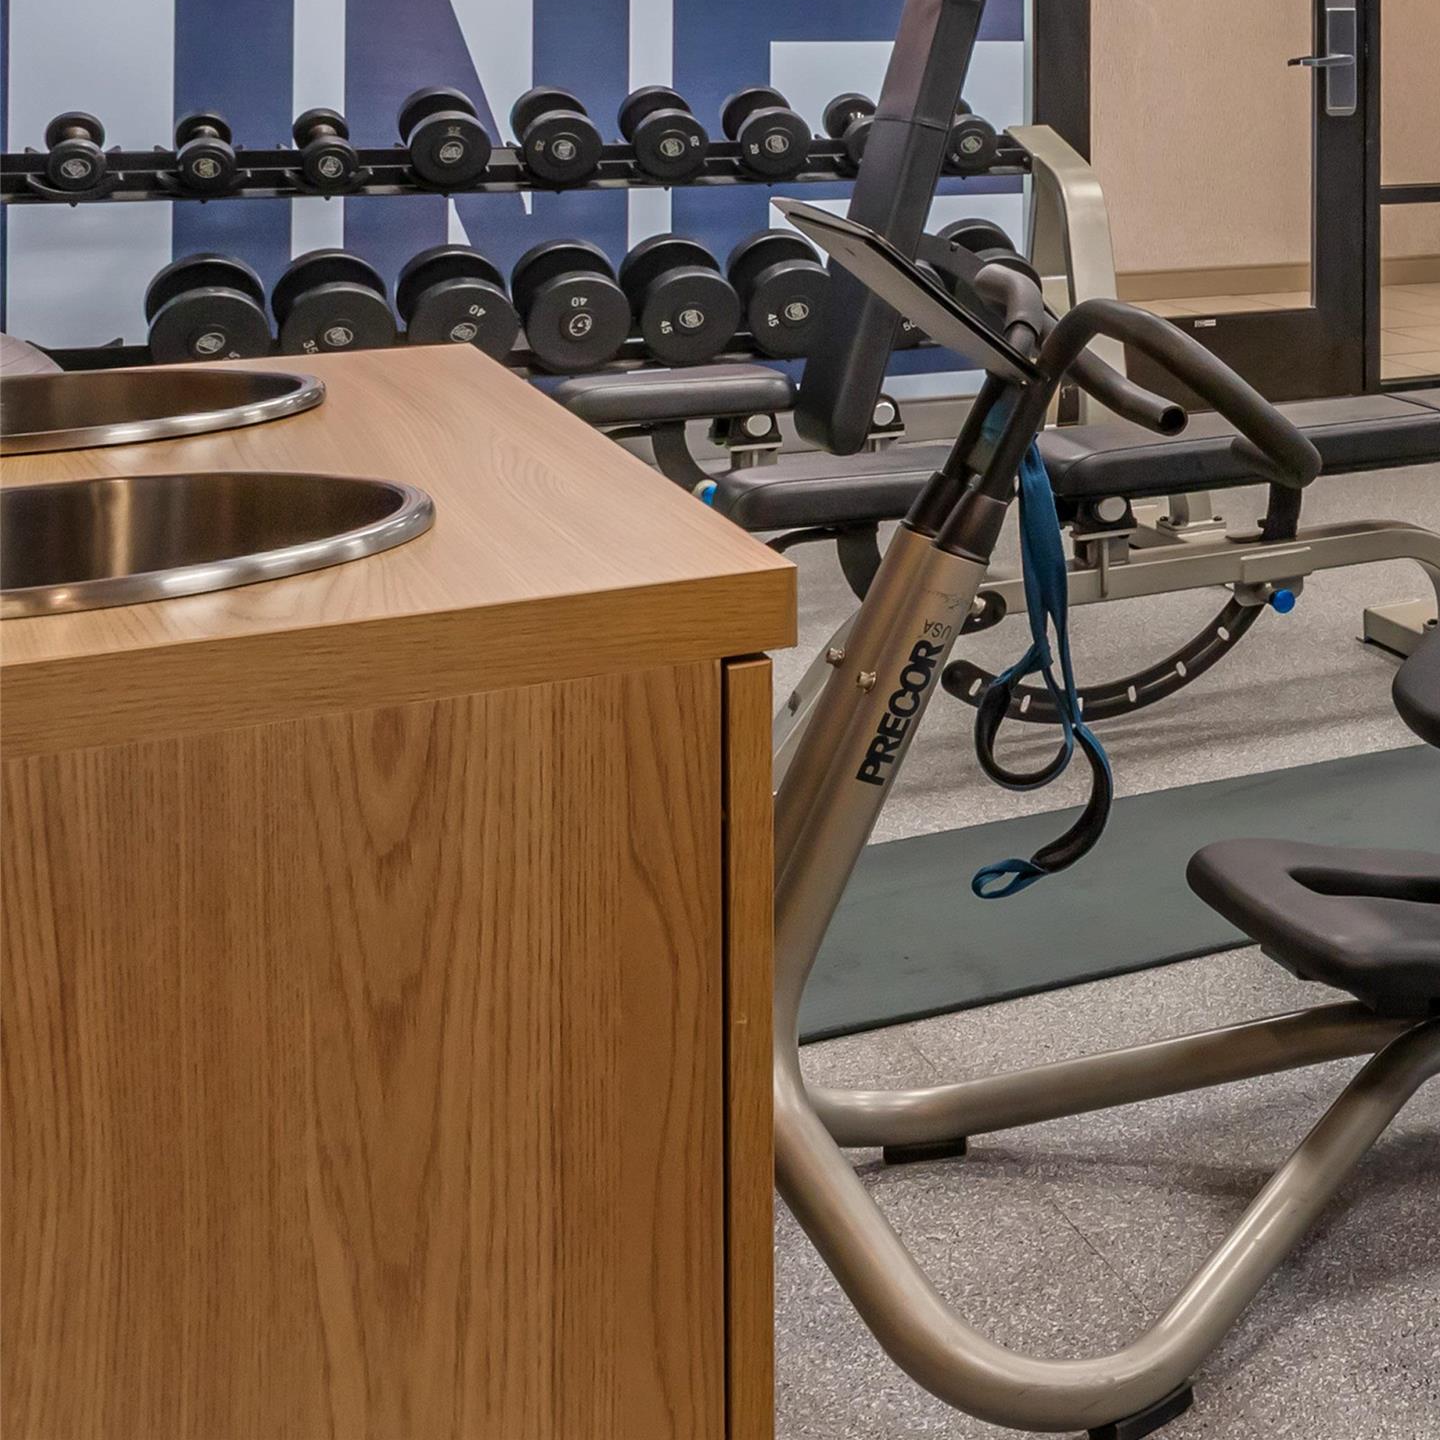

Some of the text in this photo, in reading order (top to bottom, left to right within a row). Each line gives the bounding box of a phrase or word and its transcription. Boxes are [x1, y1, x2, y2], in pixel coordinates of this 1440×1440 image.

[571, 296, 588, 308] 40
[469, 304, 486, 318] 40
[659, 320, 673, 335] 45
[767, 313, 780, 328] 45
[924, 617, 952, 640] USA
[856, 639, 945, 786] PRECOR
